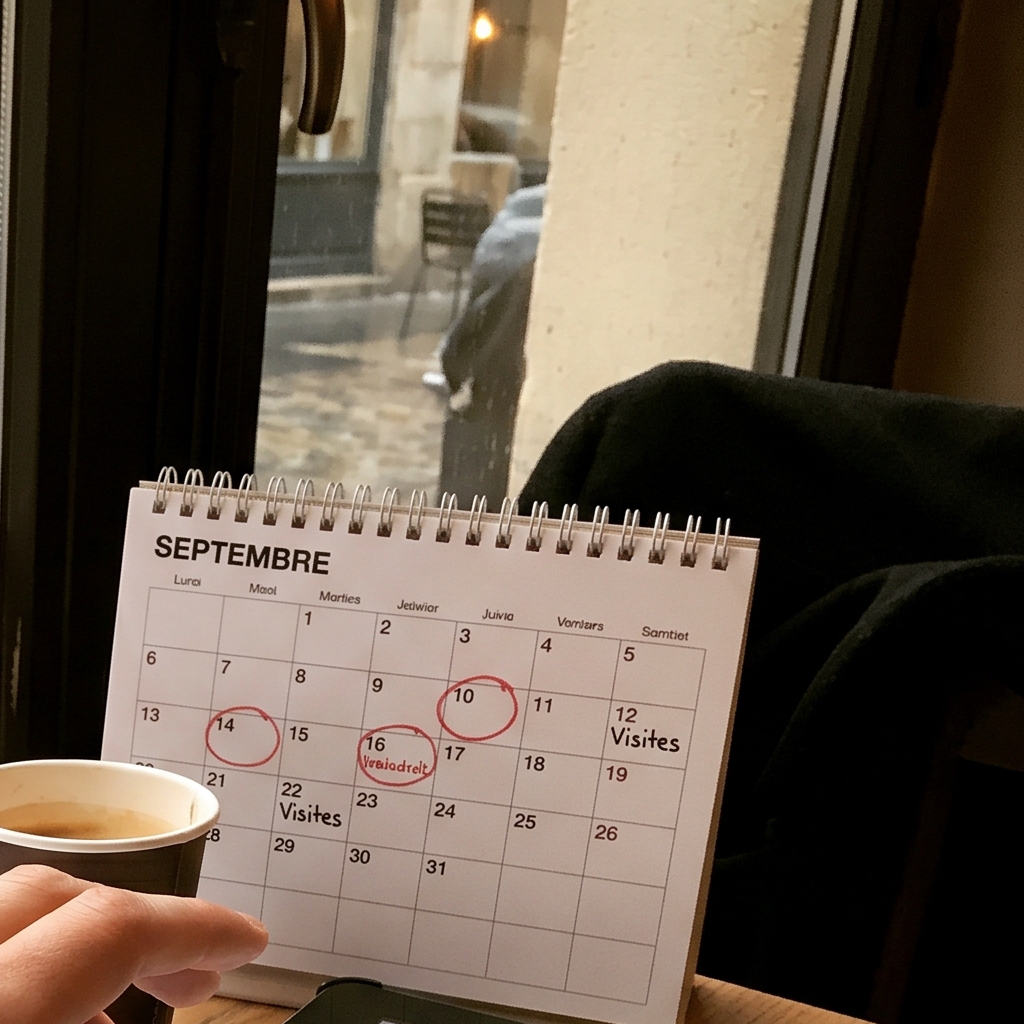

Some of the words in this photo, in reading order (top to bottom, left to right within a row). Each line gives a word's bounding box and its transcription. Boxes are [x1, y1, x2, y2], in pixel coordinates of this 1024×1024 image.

[154, 535, 331, 575] SEPTEMBRE
[304, 611, 312, 626] 1
[379, 619, 392, 635] 2
[459, 628, 471, 643] 3
[540, 637, 552, 653] 4
[623, 646, 635, 662] 5
[146, 651, 157, 665] 6
[221, 659, 231, 674] 7
[295, 668, 306, 684] 8
[372, 678, 383, 692] 9
[454, 687, 474, 704] 10
[534, 697, 553, 713] 11
[616, 706, 637, 723] 12
[141, 707, 160, 722] 13
[216, 717, 235, 732] 14
[289, 726, 309, 742] 15
[366, 736, 385, 751] 16
[445, 746, 465, 761] 17
[524, 755, 545, 772] 18
[606, 765, 627, 782] 19
[610, 727, 680, 753] Visites
[206, 772, 225, 788] 21
[281, 782, 302, 798] 22
[356, 792, 377, 808] 23
[433, 802, 456, 819] 24
[513, 813, 537, 830] 25
[594, 824, 618, 841] 26
[279, 802, 342, 828] Visites
[273, 838, 295, 853] 29
[349, 848, 371, 865] 30
[425, 859, 446, 876] 31
